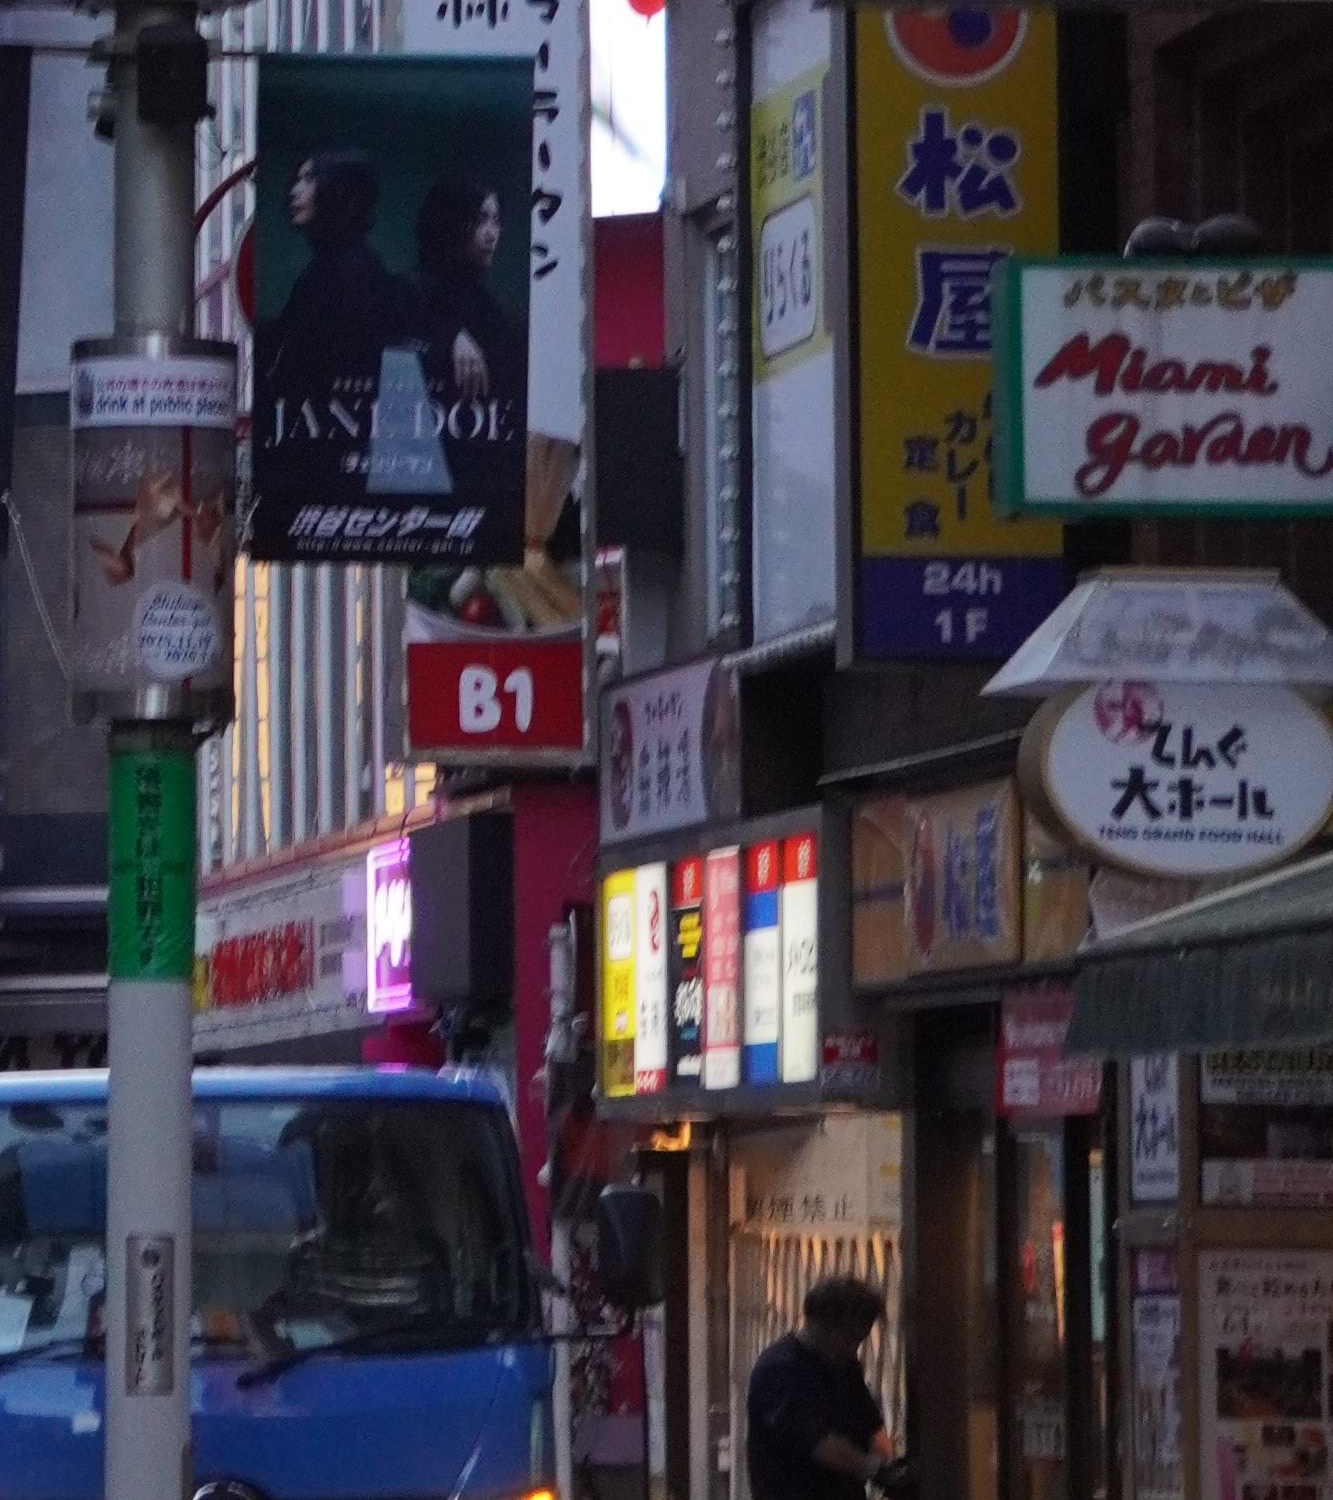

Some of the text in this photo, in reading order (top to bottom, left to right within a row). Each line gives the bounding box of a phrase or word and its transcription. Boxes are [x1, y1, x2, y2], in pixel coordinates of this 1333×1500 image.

[899, 109, 1024, 357] 松屋
[1033, 331, 1279, 397] Miami
[945, 408, 980, 522] カレー
[288, 503, 487, 540] 渋谷センター街
[922, 561, 1003, 596] 24h
[934, 607, 989, 644] 1F
[459, 664, 532, 736] B1
[1140, 724, 1247, 769] てんぐ
[1110, 764, 1274, 822] 大ホール
